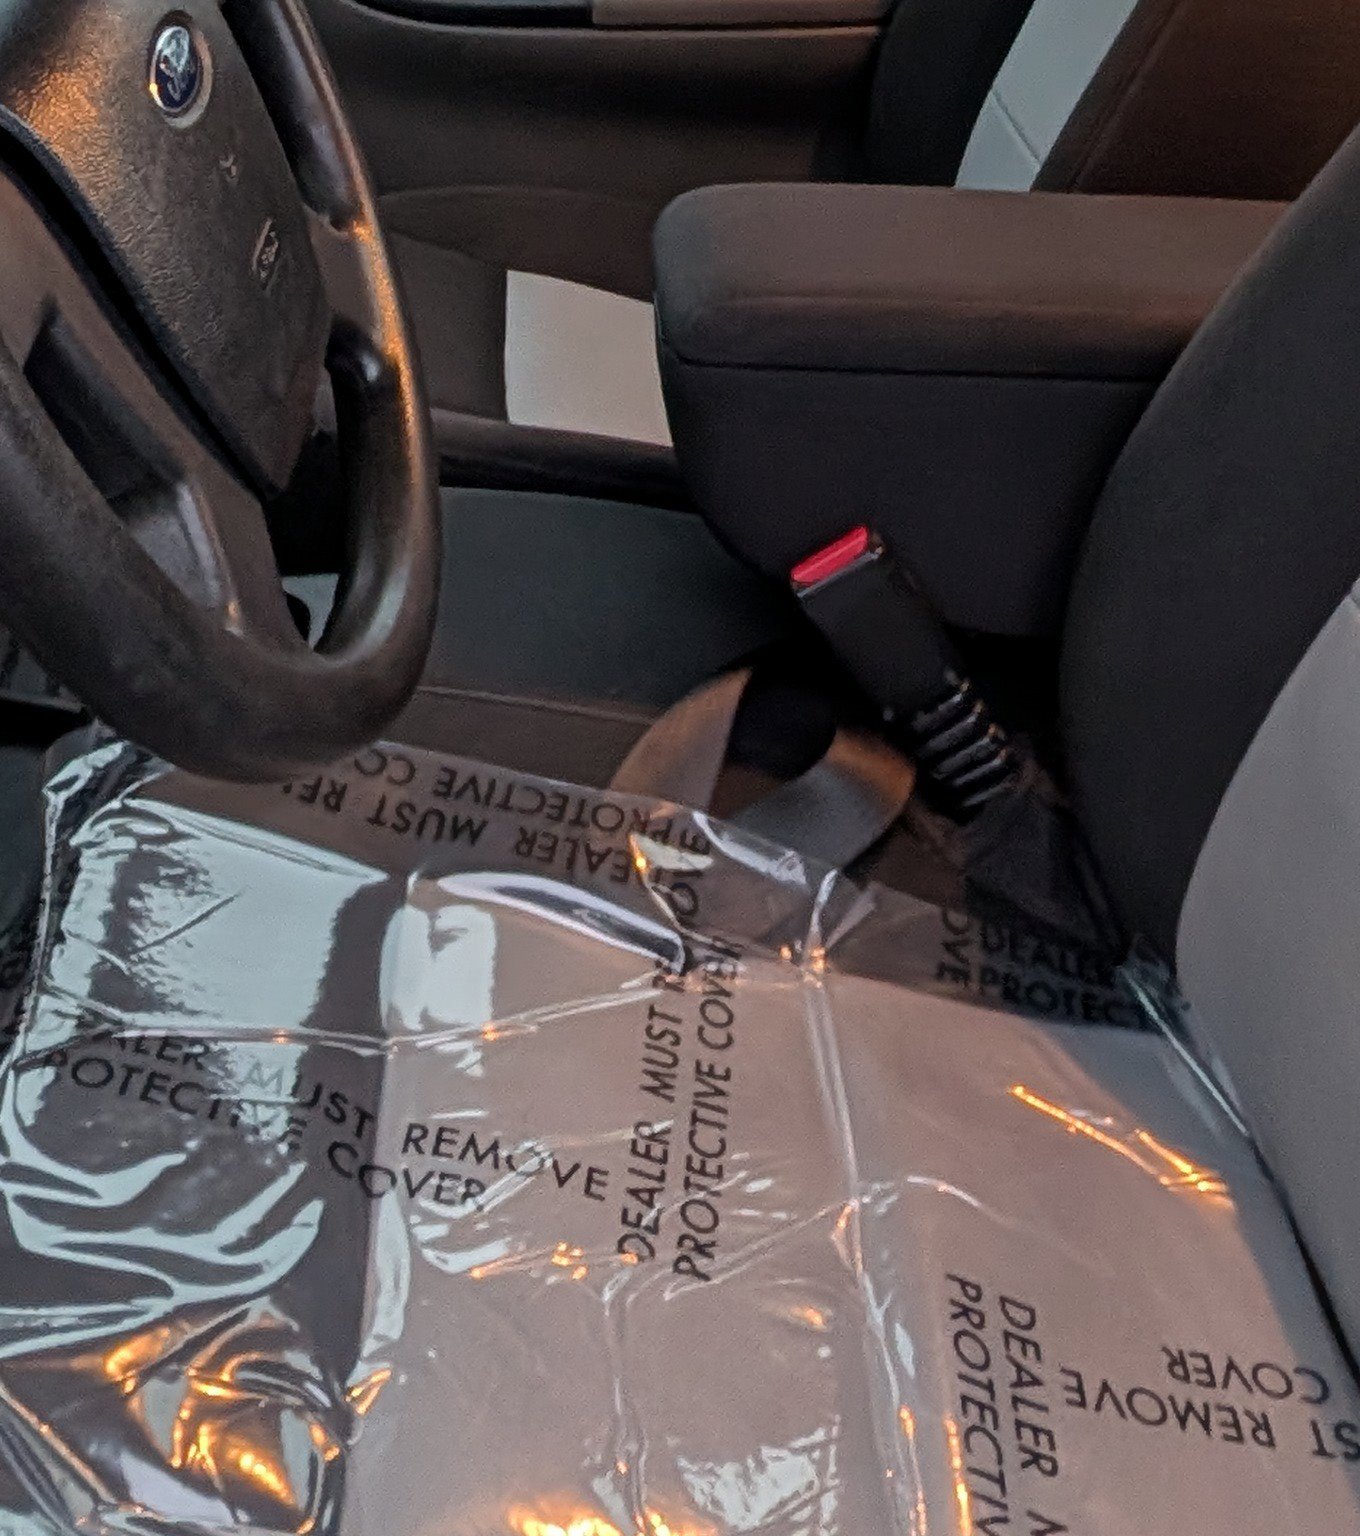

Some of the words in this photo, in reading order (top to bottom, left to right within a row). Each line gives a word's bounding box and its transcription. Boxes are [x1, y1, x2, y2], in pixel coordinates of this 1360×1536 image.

[367, 792, 489, 847] MUST
[639, 1004, 683, 1103] MUST
[617, 1120, 672, 1262] DEALER
[672, 1059, 732, 1282] PROTECTIVE
[946, 1273, 1011, 1536] PROTECTIV
[999, 1294, 1059, 1477] DEALER
[1059, 1366, 1276, 1449] REMOVE
[1161, 1345, 1330, 1405] COVER
